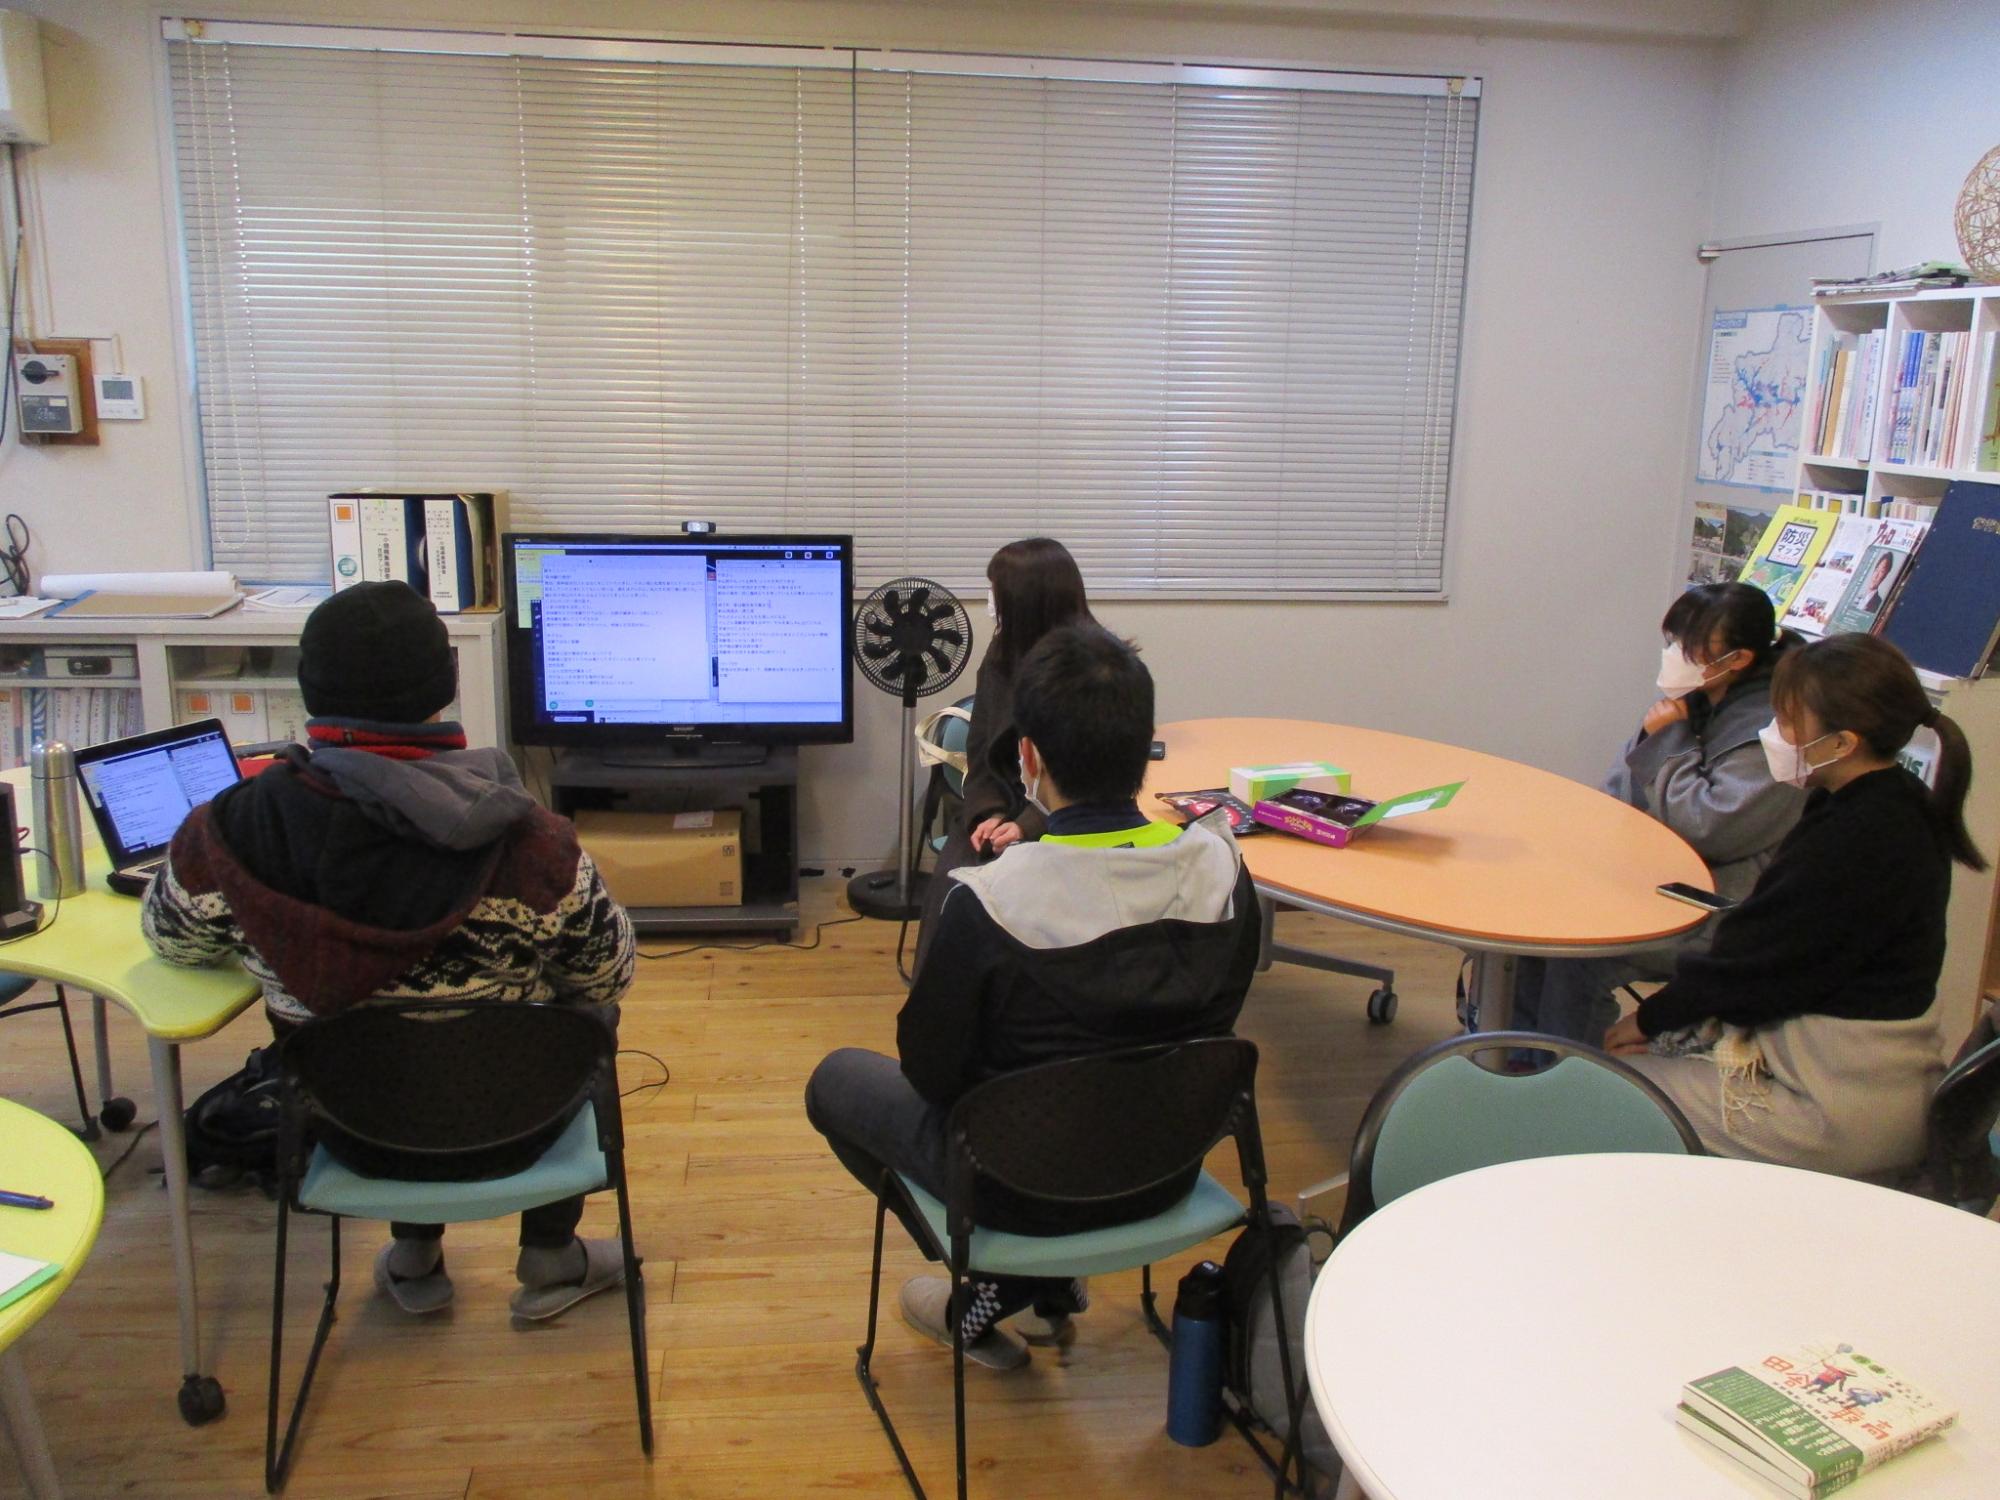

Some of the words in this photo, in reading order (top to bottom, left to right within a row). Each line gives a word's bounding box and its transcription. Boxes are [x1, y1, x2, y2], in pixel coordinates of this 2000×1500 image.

[1781, 528, 1811, 547] 防災
[1778, 544, 1804, 556] マップ
